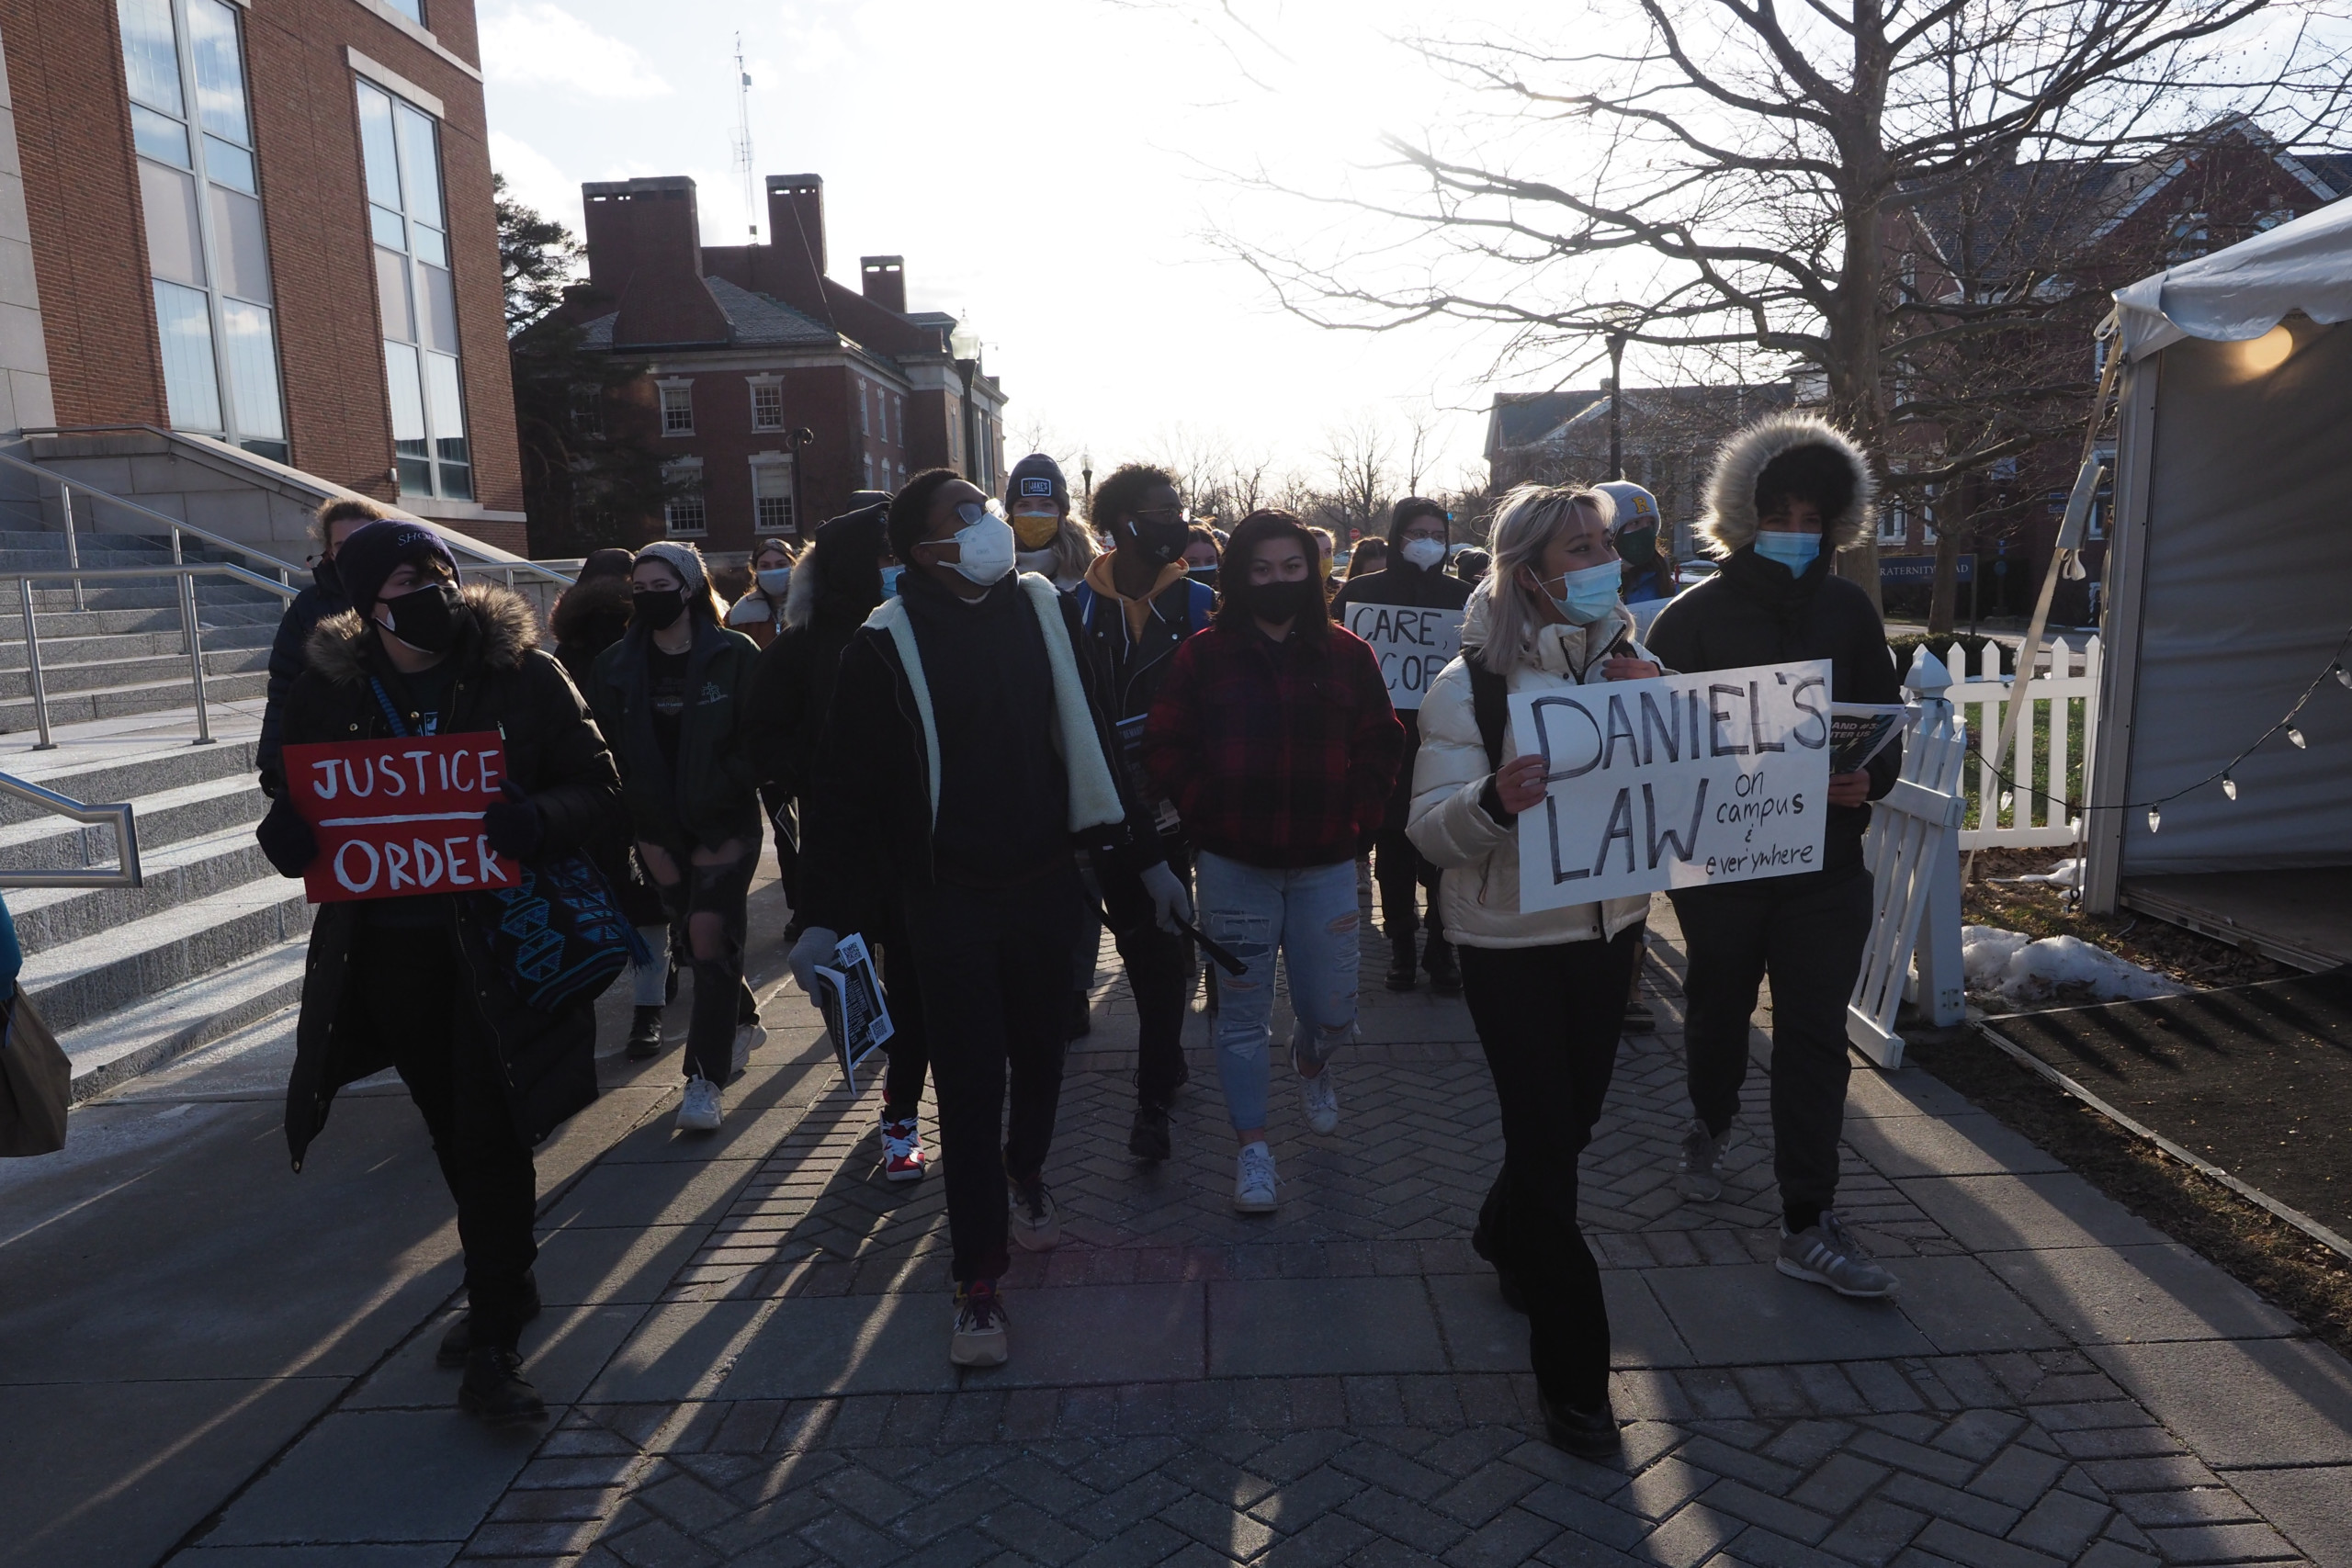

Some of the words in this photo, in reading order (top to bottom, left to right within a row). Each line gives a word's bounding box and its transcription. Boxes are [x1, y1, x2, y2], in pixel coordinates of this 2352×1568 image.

[1880, 565, 1936, 576] RATERNITY
[1352, 606, 1448, 650] CARE,
[1380, 652, 1450, 694] COP
[1531, 671, 1826, 783] DANIEL'S
[311, 750, 502, 799] JUSTICE
[1735, 772, 1764, 797] on
[1716, 793, 1804, 827] campus
[1546, 778, 1709, 886] LAW
[334, 834, 508, 893] ORDER
[1705, 843, 1814, 875] everywhere
